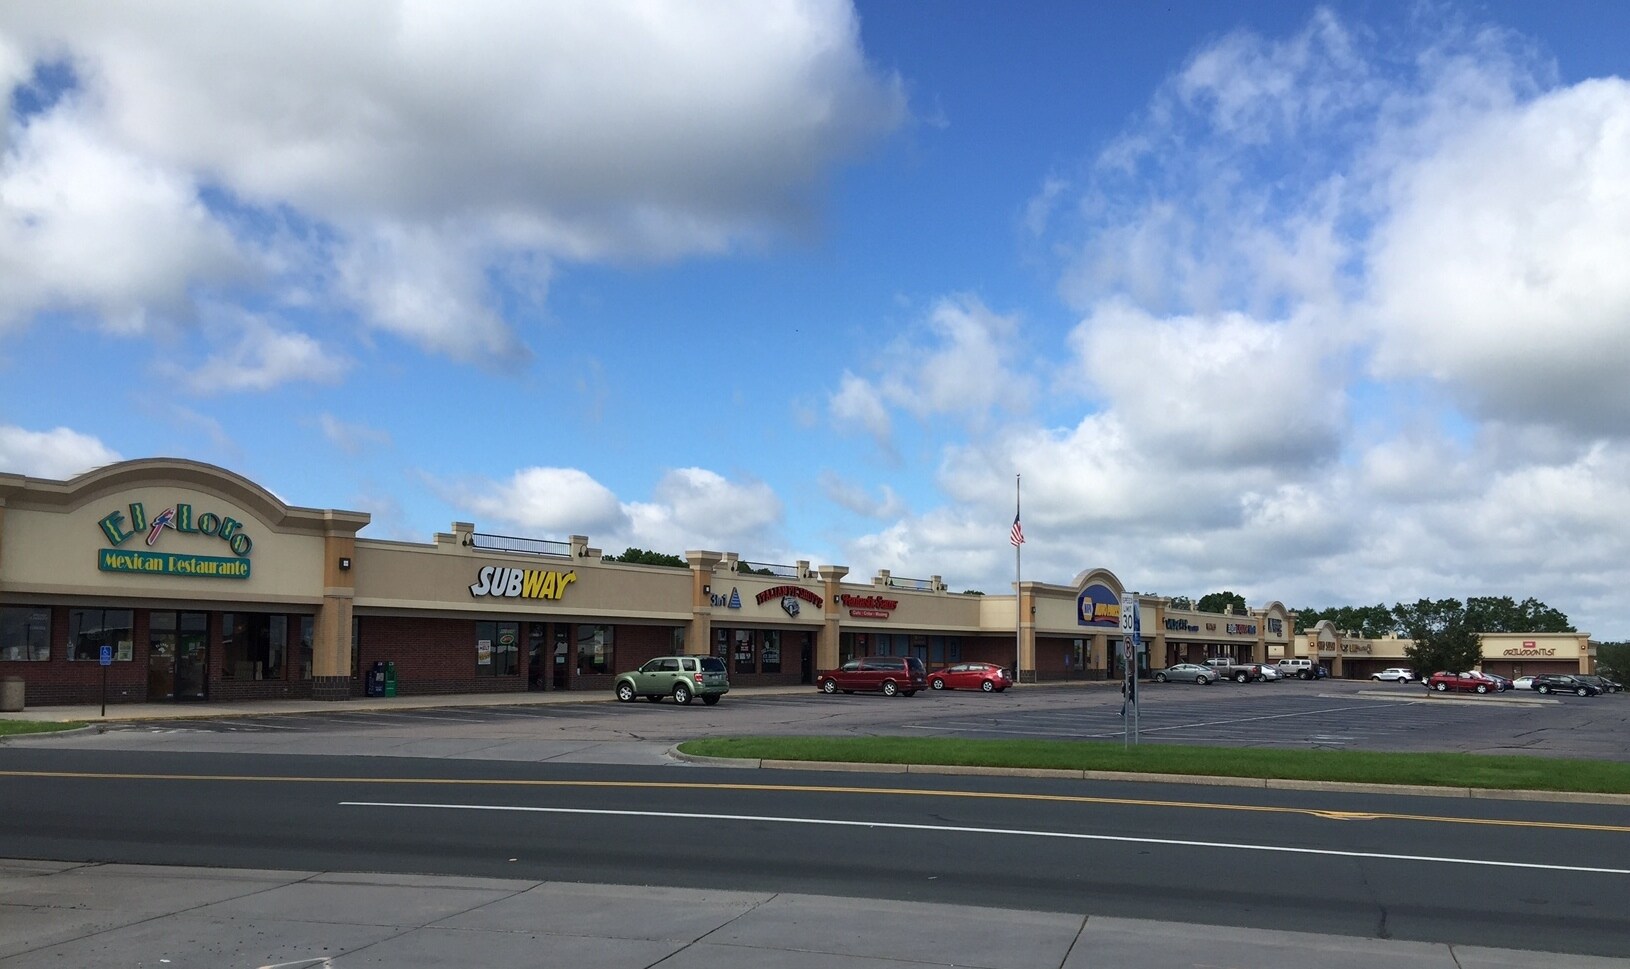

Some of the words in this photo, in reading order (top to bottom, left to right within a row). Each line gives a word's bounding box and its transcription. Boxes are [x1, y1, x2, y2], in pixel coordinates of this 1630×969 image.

[98, 502, 146, 546] El
[177, 504, 253, 556] Loro
[104, 553, 163, 572] Mexican
[168, 556, 248, 576] Restaurante
[470, 566, 576, 600] SUBWAY
[1122, 614, 1133, 629] 30
